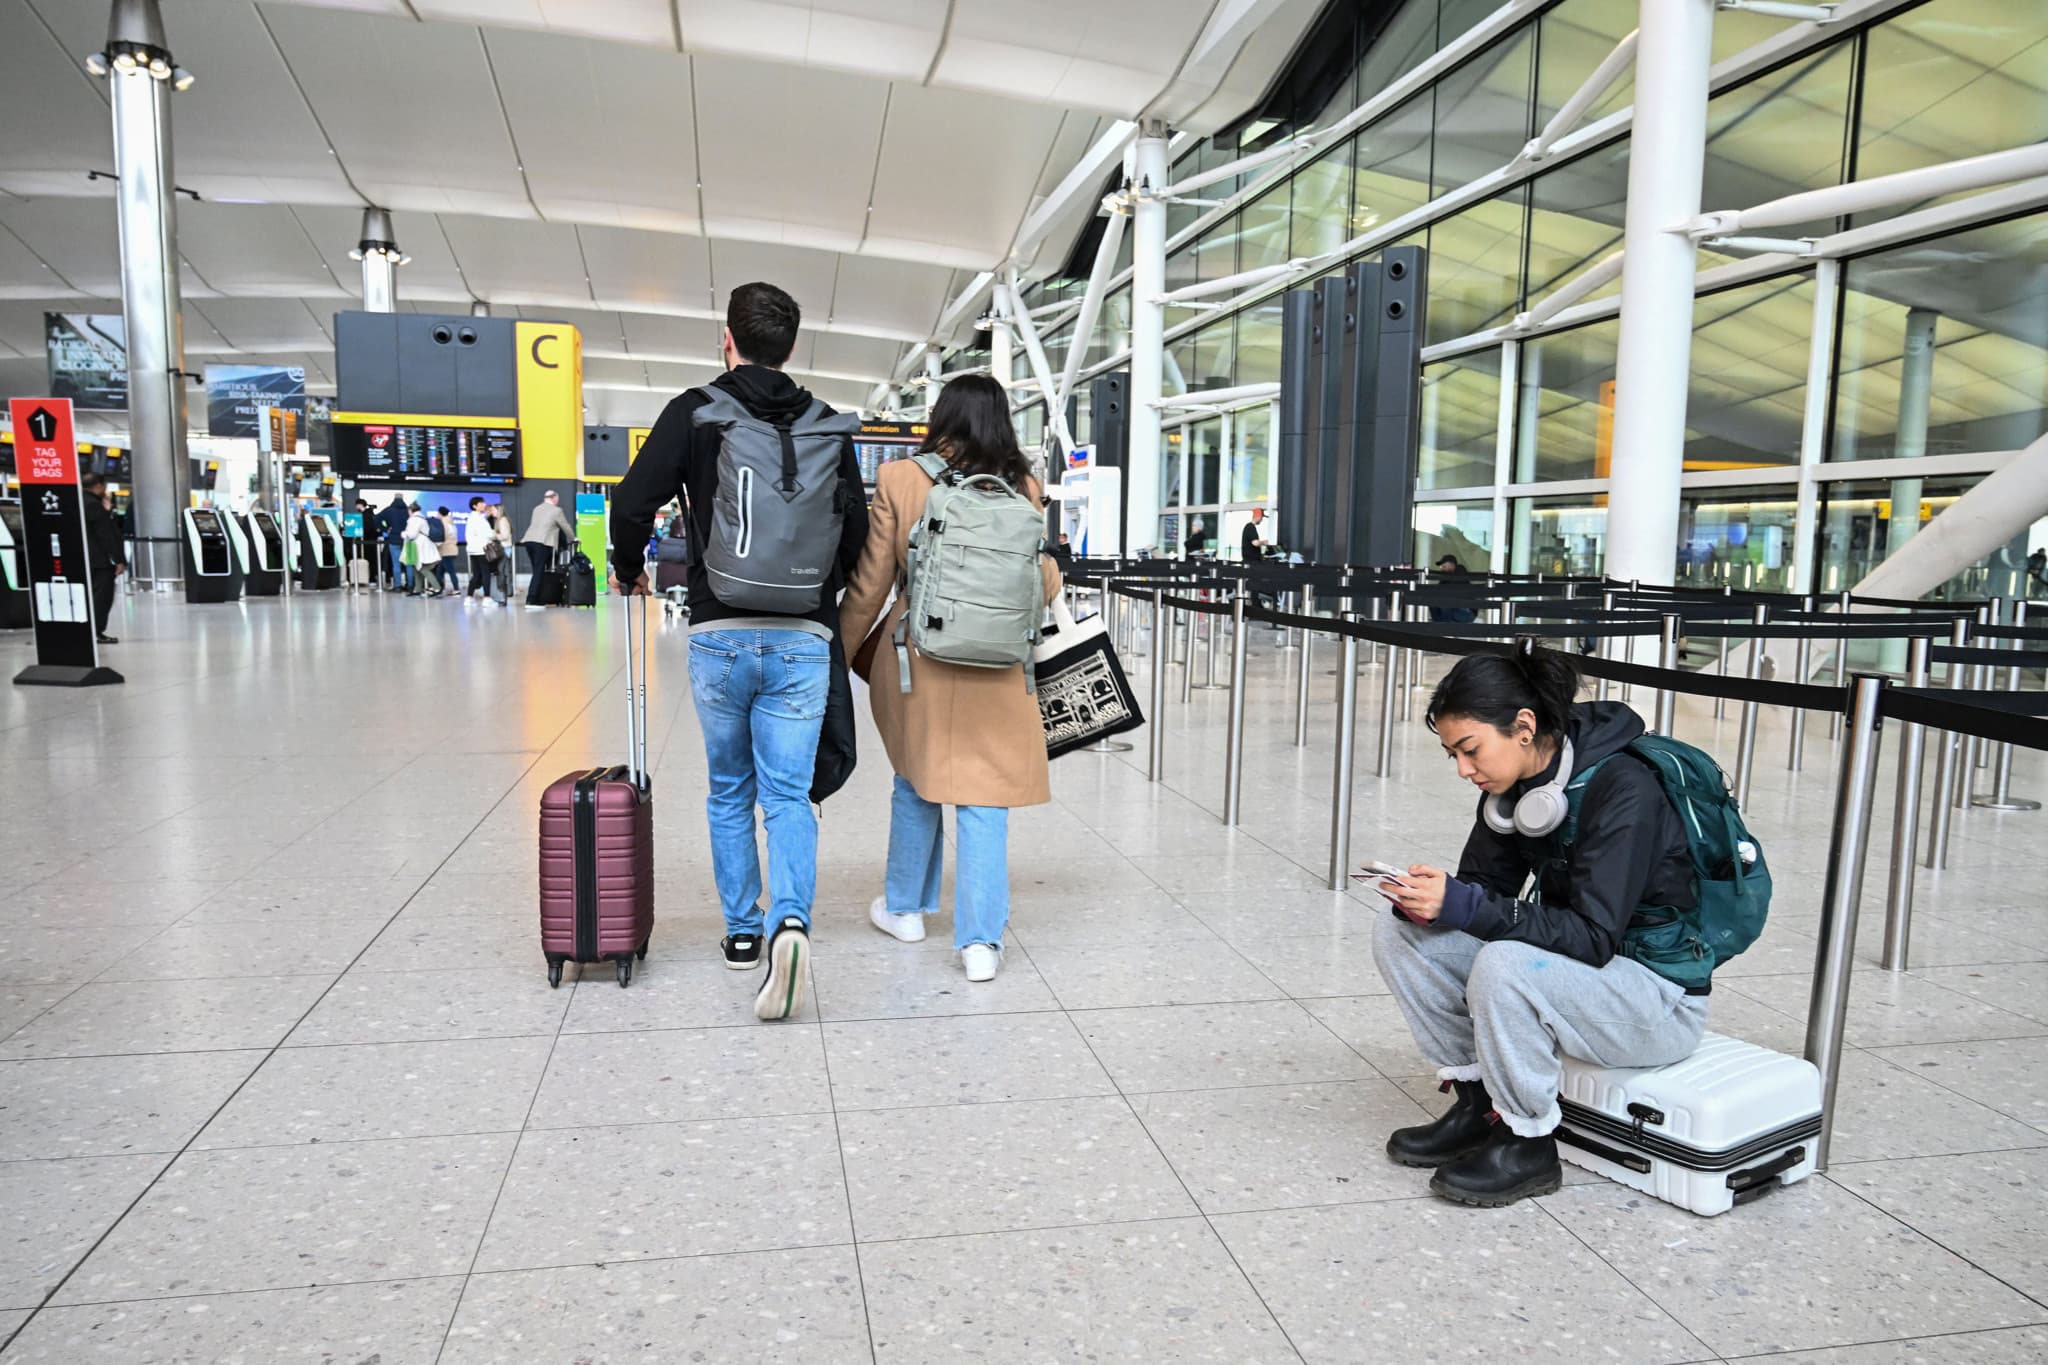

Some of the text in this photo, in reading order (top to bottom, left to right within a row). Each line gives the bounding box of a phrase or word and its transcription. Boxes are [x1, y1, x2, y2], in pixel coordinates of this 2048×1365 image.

[532, 335, 559, 369] C
[35, 413, 47, 438] 1
[34, 447, 56, 458] TAG
[32, 457, 62, 468] YOUR
[33, 467, 63, 478] BAGS
